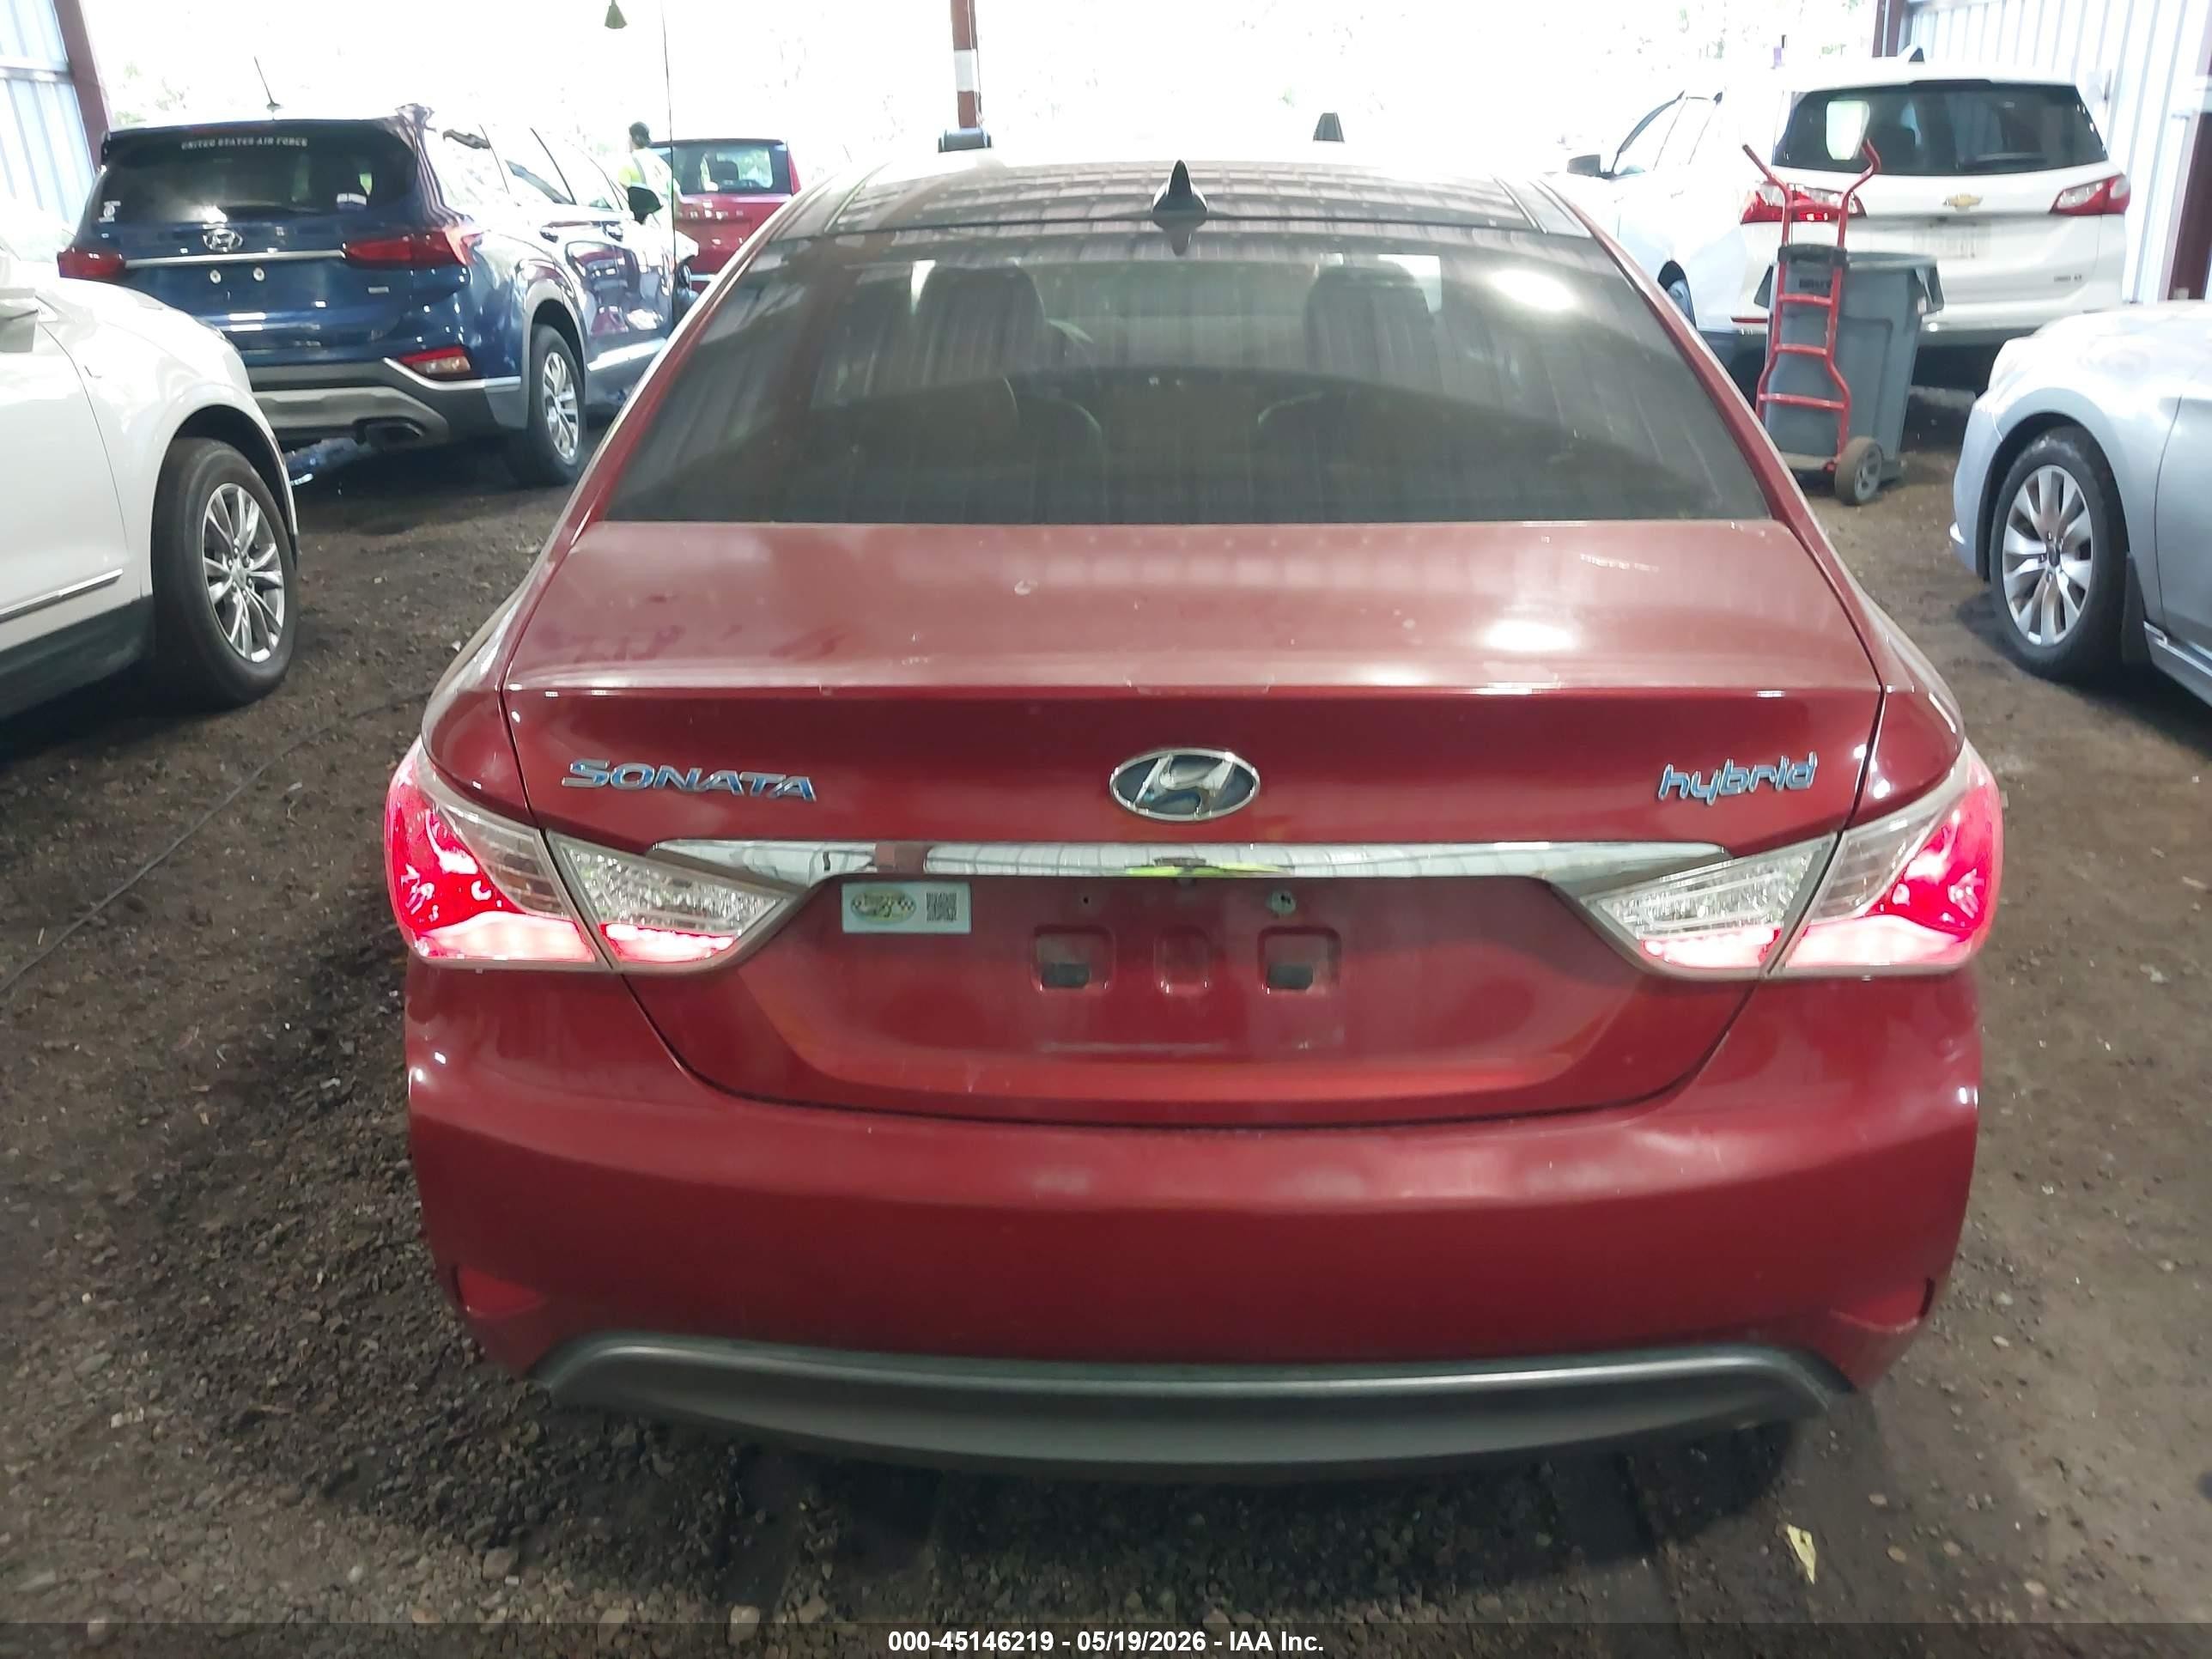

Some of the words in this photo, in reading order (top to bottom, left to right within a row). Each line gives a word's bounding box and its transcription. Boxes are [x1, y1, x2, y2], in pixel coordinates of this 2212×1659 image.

[257, 136, 274, 145] AIR
[276, 137, 308, 147] FORCE
[562, 758, 817, 802] SONATA
[1658, 750, 1819, 806] hybrid
